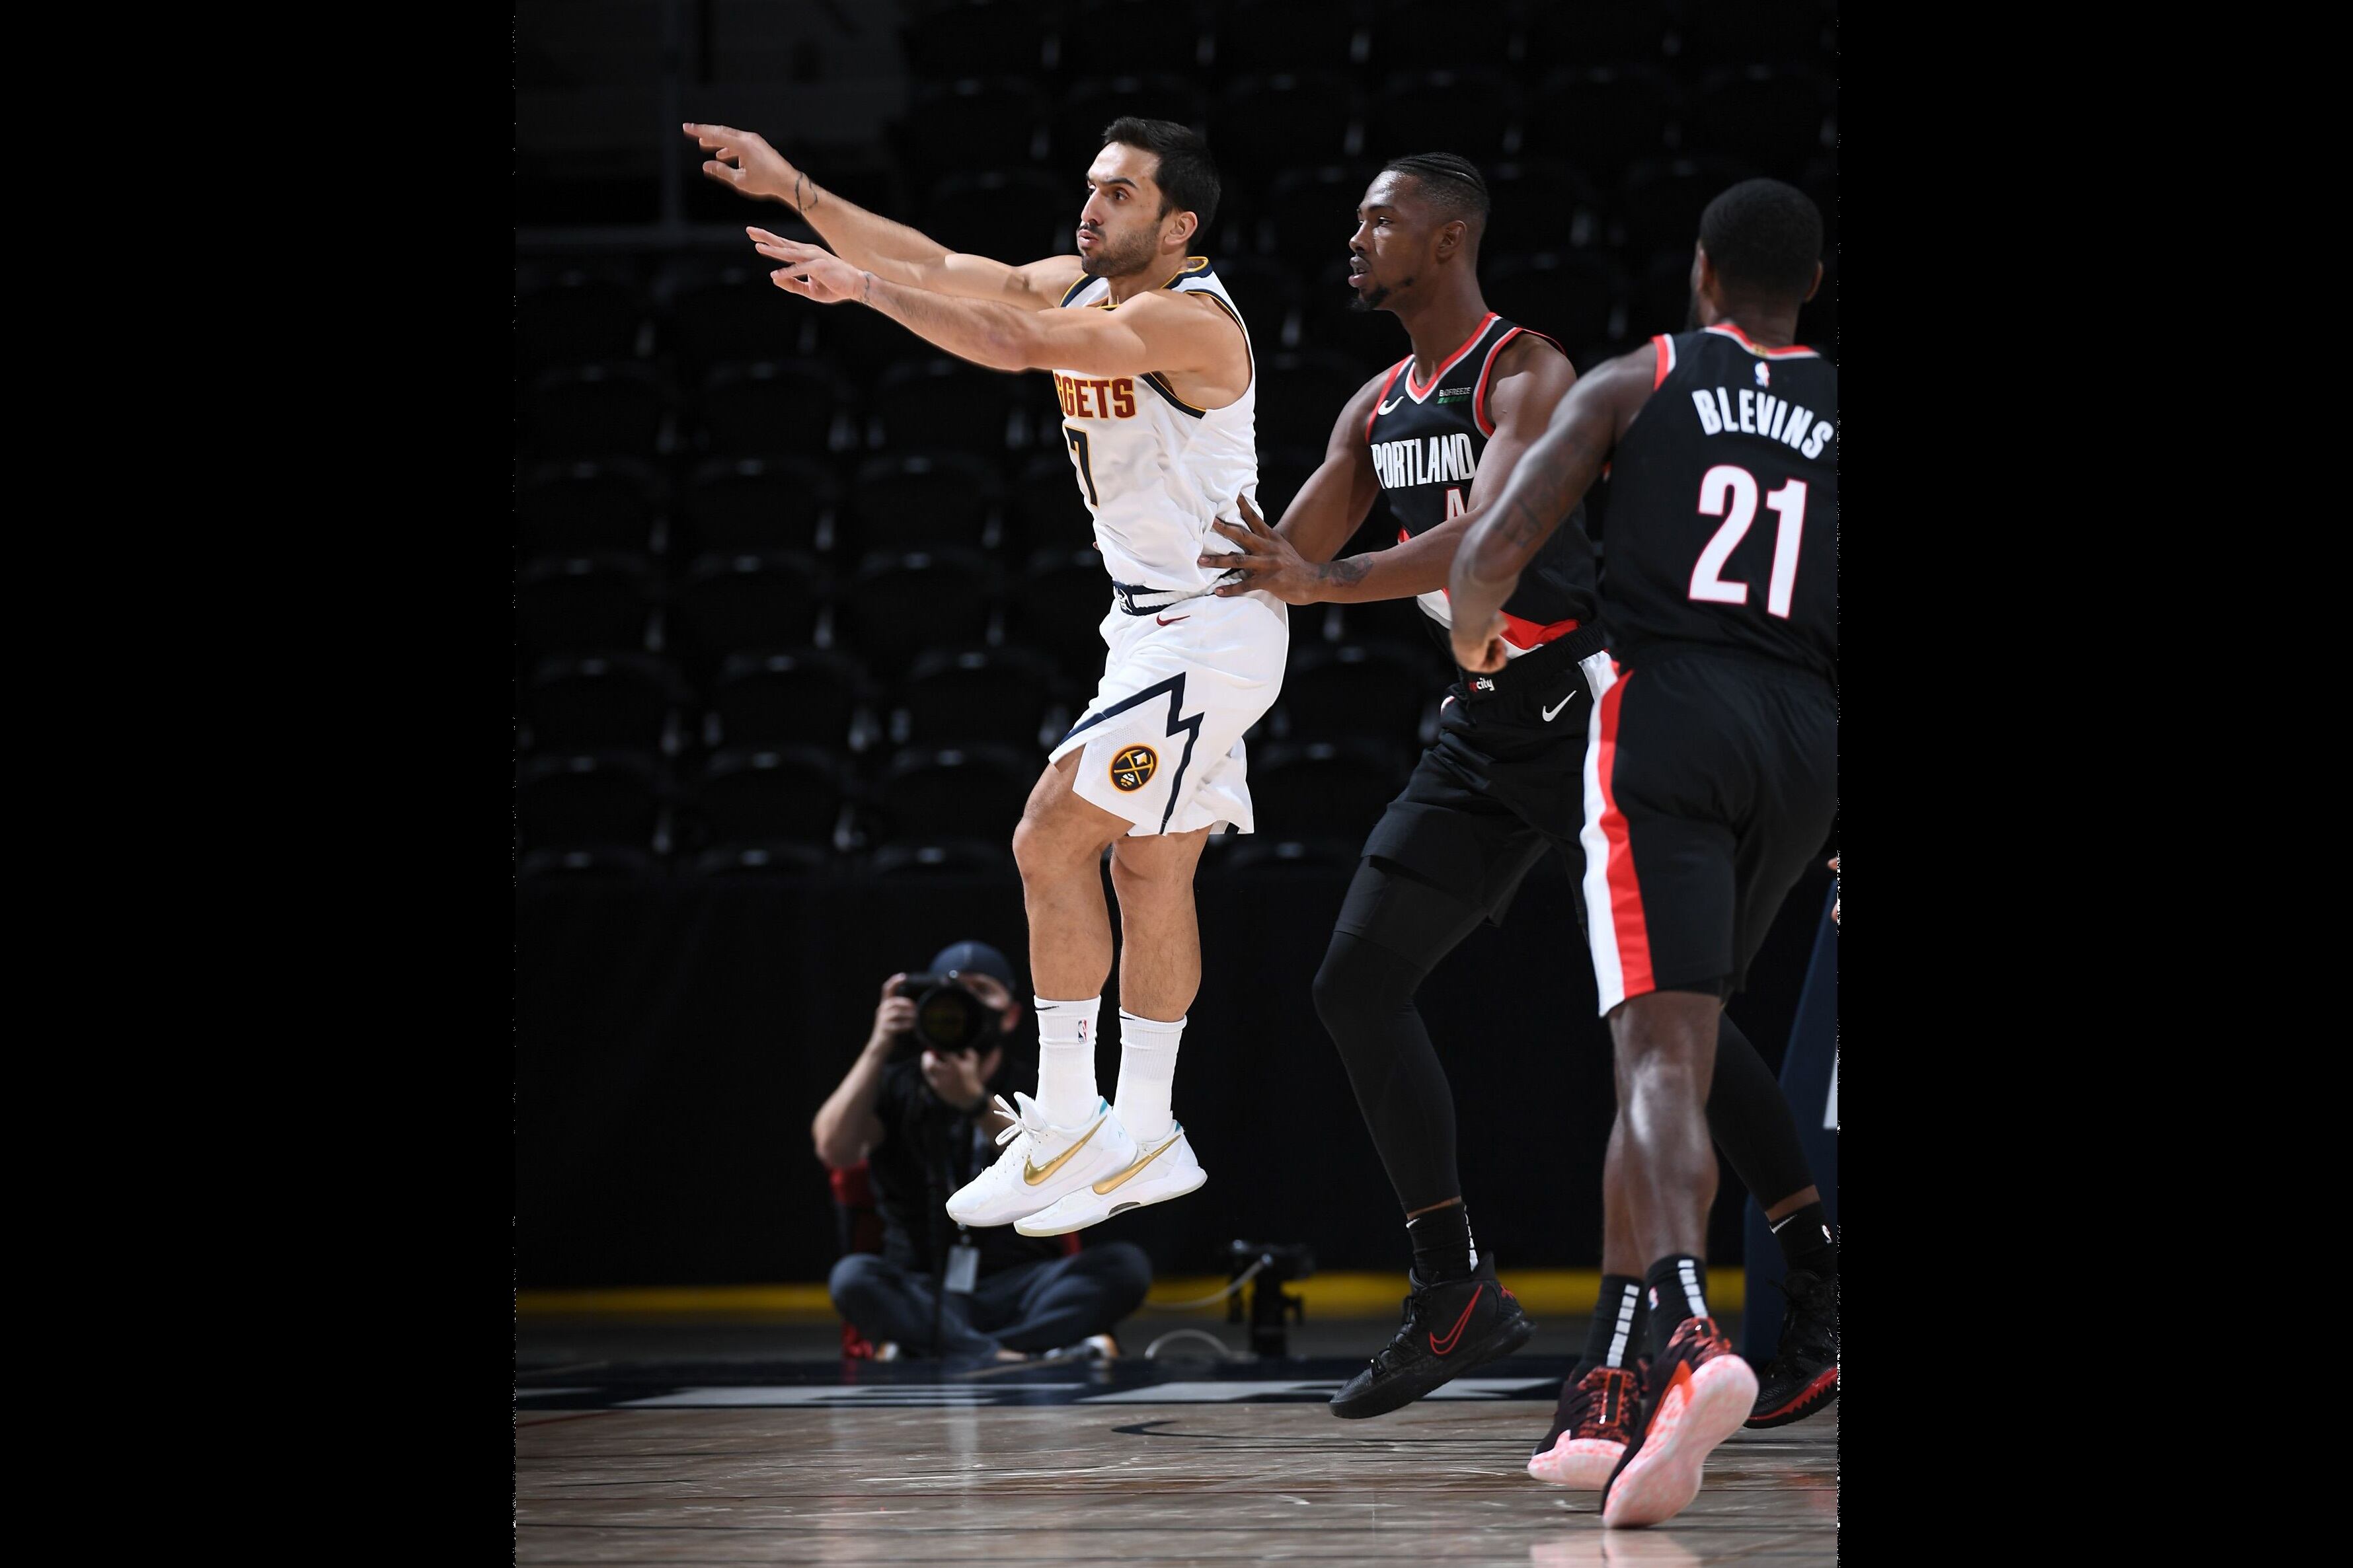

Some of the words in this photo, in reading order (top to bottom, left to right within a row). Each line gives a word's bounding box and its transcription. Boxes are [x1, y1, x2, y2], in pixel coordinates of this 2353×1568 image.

[1370, 433, 1477, 490] PORTLAND
[1691, 387, 1834, 460] BLEVINS
[1064, 425, 1099, 509] 7
[1687, 465, 1808, 620] 21
